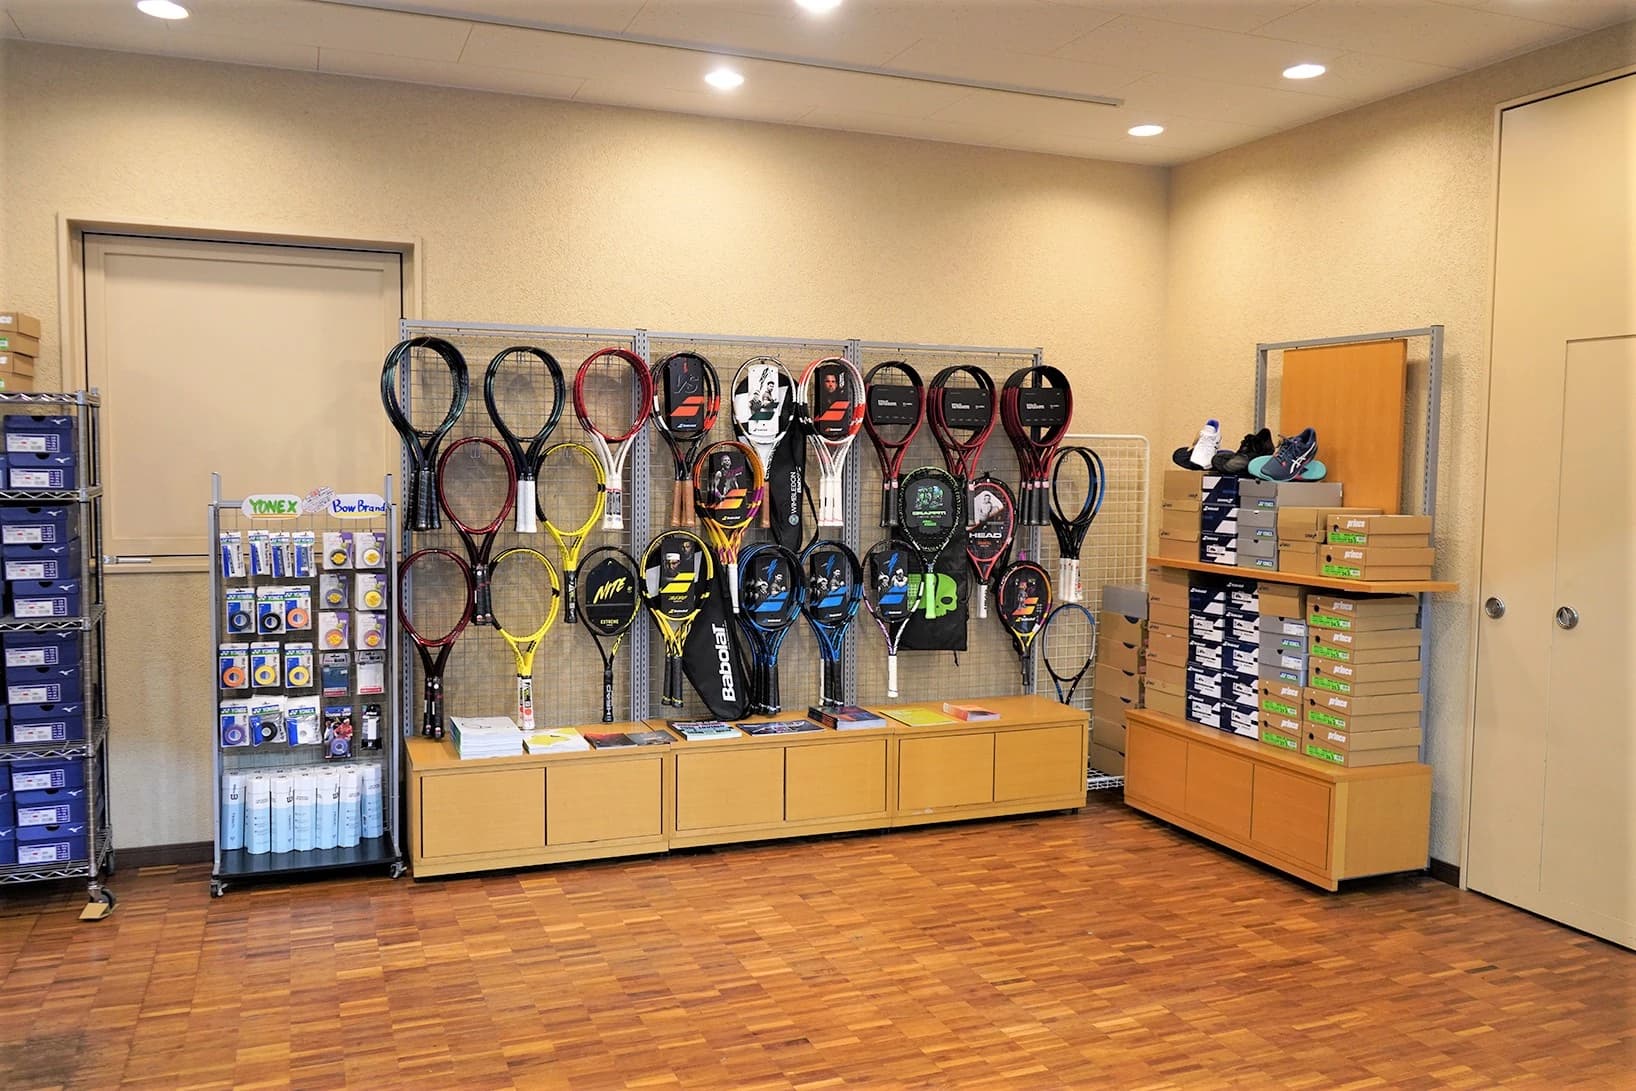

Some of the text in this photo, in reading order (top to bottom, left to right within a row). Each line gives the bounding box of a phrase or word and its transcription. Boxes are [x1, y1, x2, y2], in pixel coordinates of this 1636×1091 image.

[674, 374, 699, 393] VS
[249, 498, 297, 514] YONEX
[332, 498, 355, 513] Bow
[357, 499, 386, 513] Brand
[593, 577, 627, 604] NITE
[712, 623, 736, 702] Babolat
